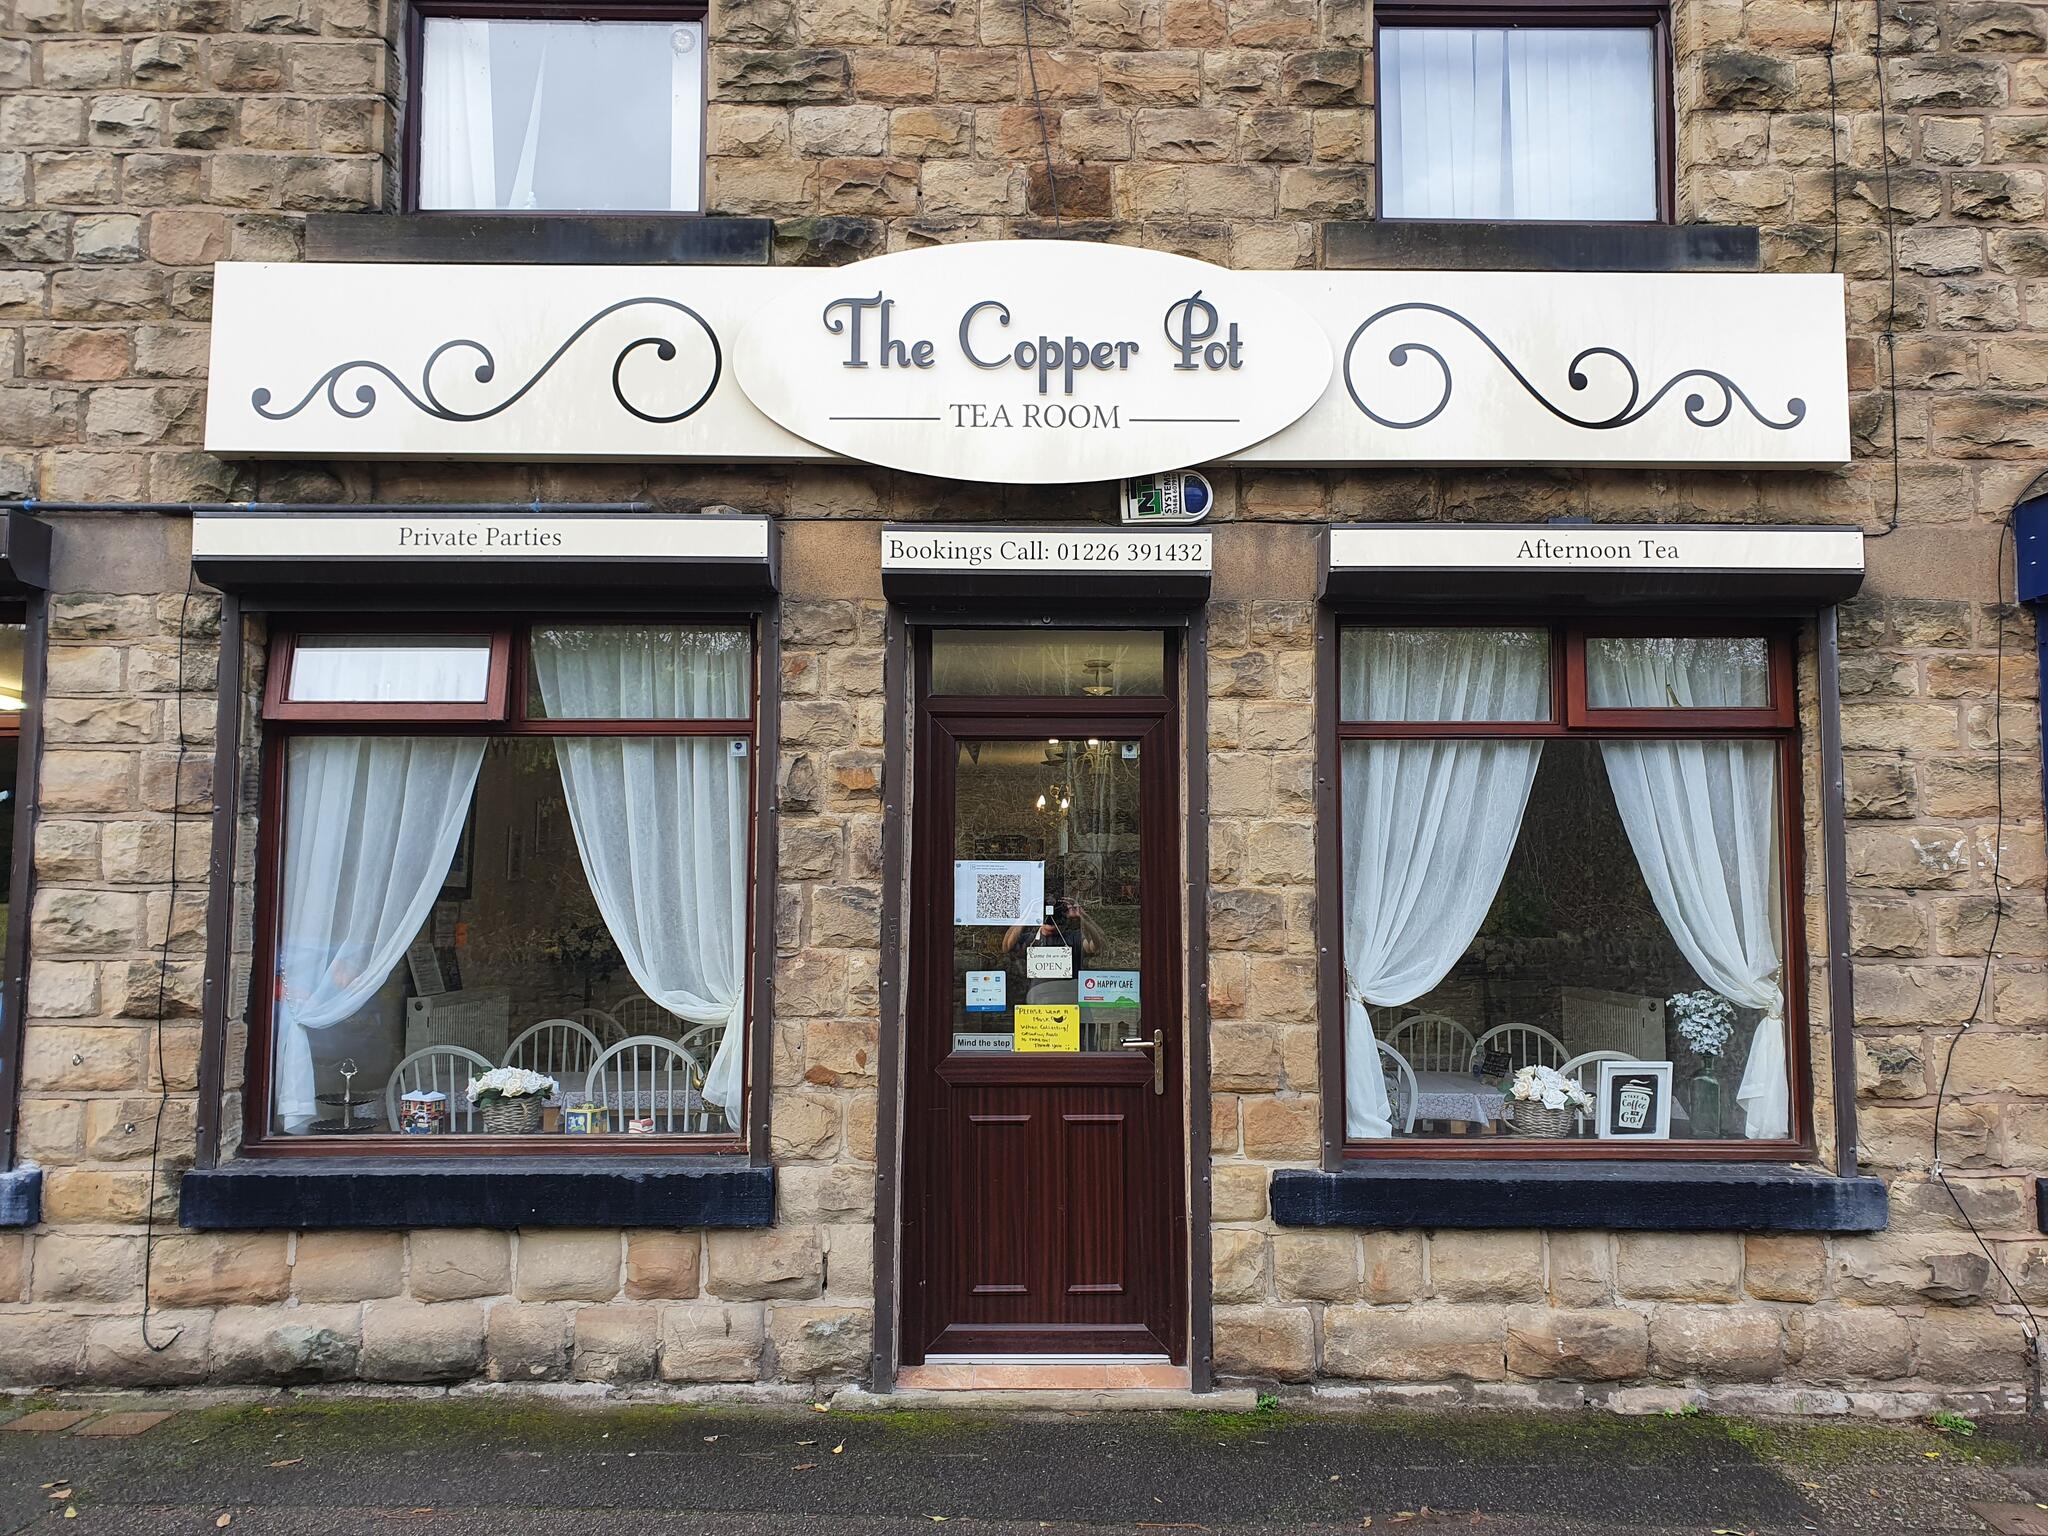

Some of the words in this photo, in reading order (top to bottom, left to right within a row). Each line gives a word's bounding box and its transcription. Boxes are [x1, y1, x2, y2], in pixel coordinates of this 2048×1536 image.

[823, 290, 936, 369] The
[958, 300, 1140, 395] Copper
[1163, 289, 1245, 370] Pot
[949, 403, 1014, 429] TEA
[1022, 404, 1121, 430] ROOM
[1164, 472, 1173, 514] SYSTEMS
[399, 527, 478, 546] Private
[485, 527, 562, 546] Parties
[889, 540, 992, 566] Bookings
[1000, 541, 1049, 560] Call:
[1057, 543, 1119, 561] 01226
[1127, 543, 1202, 562] 391432
[1517, 539, 1632, 559] Afternoon
[1638, 540, 1679, 559] Tea
[1035, 962, 1063, 971] OPEN
[1097, 980, 1117, 988] HAPPY
[1118, 979, 1134, 989] CAFÉ
[957, 1039, 976, 1047] Mind
[979, 1039, 991, 1047] the
[993, 1040, 1010, 1048] step
[1621, 1099, 1647, 1110] Coffee
